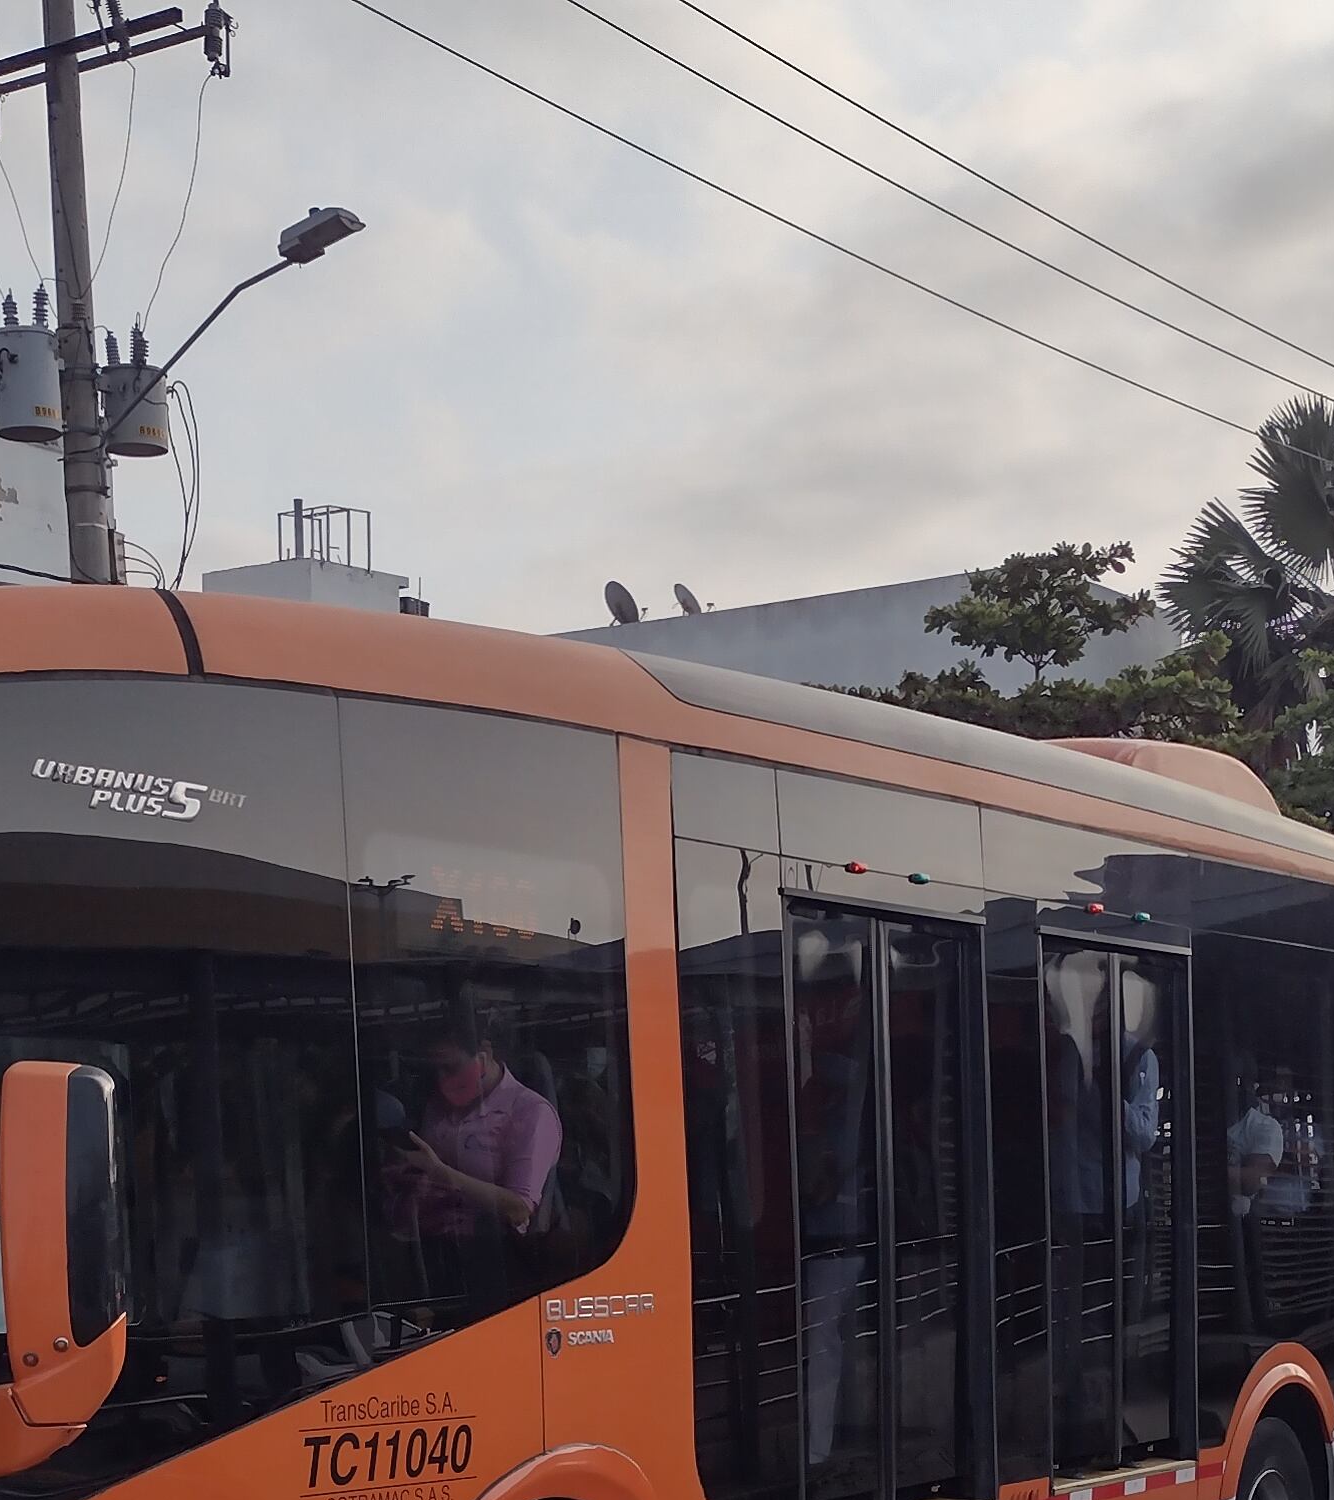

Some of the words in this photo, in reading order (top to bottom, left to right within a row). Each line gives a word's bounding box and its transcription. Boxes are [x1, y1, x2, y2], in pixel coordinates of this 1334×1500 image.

[208, 788, 248, 809] BRT
[546, 1293, 655, 1321] BUSSCAR
[567, 1329, 616, 1346] SCANIA
[320, 1395, 420, 1423] TransCaribe
[425, 1391, 458, 1415] S.A.
[303, 1424, 472, 1489] TC11040
